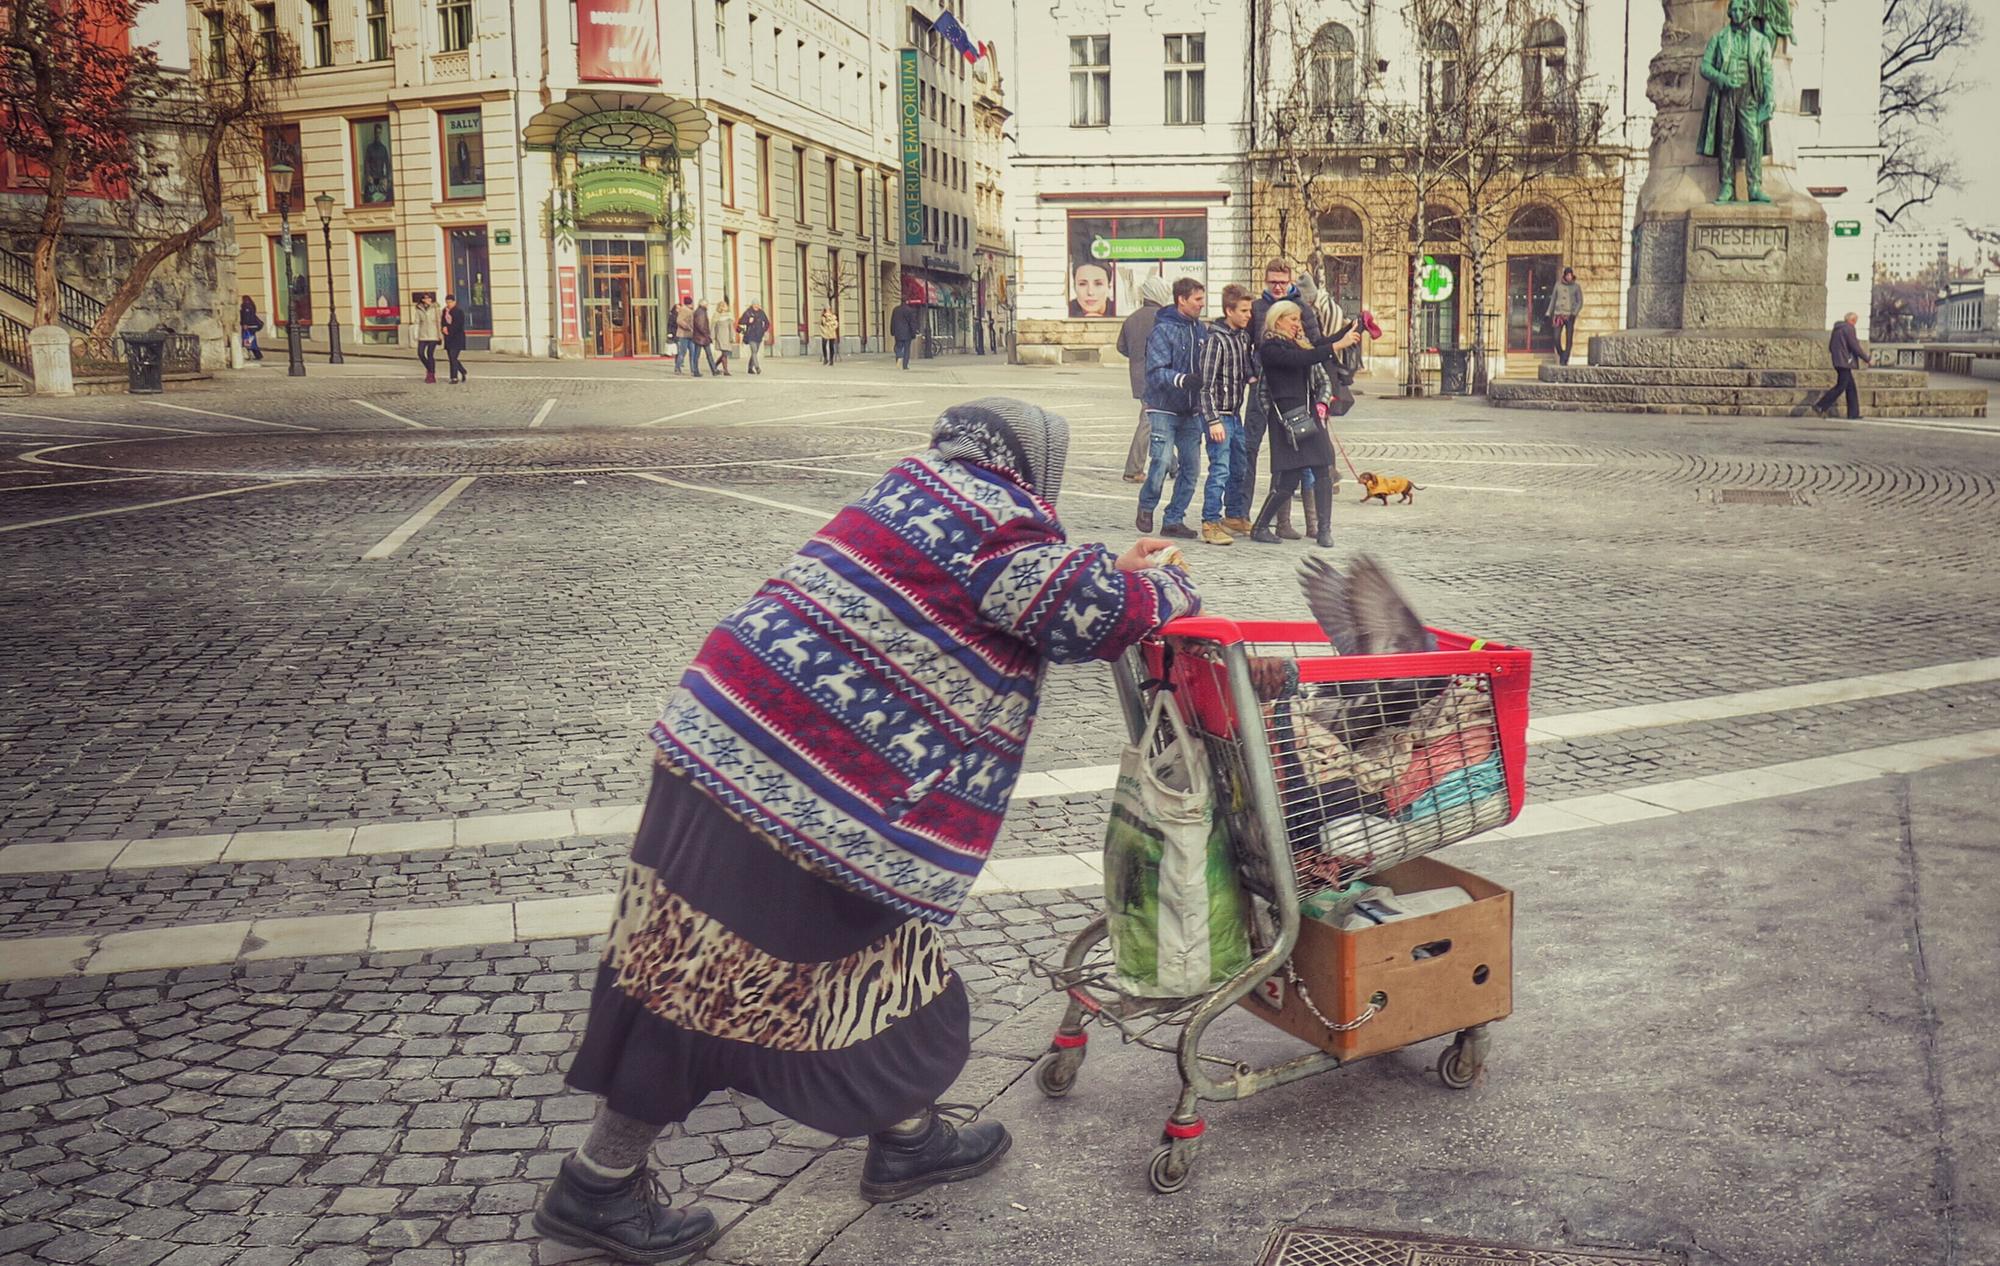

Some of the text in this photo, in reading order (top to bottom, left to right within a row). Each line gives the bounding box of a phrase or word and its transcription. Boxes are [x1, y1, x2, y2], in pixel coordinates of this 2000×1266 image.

[450, 119, 479, 129] BALLY
[904, 58, 921, 236] GALERIJA EMPORIUM
[585, 187, 617, 199] GALERIJA
[1265, 981, 1279, 999] 2
